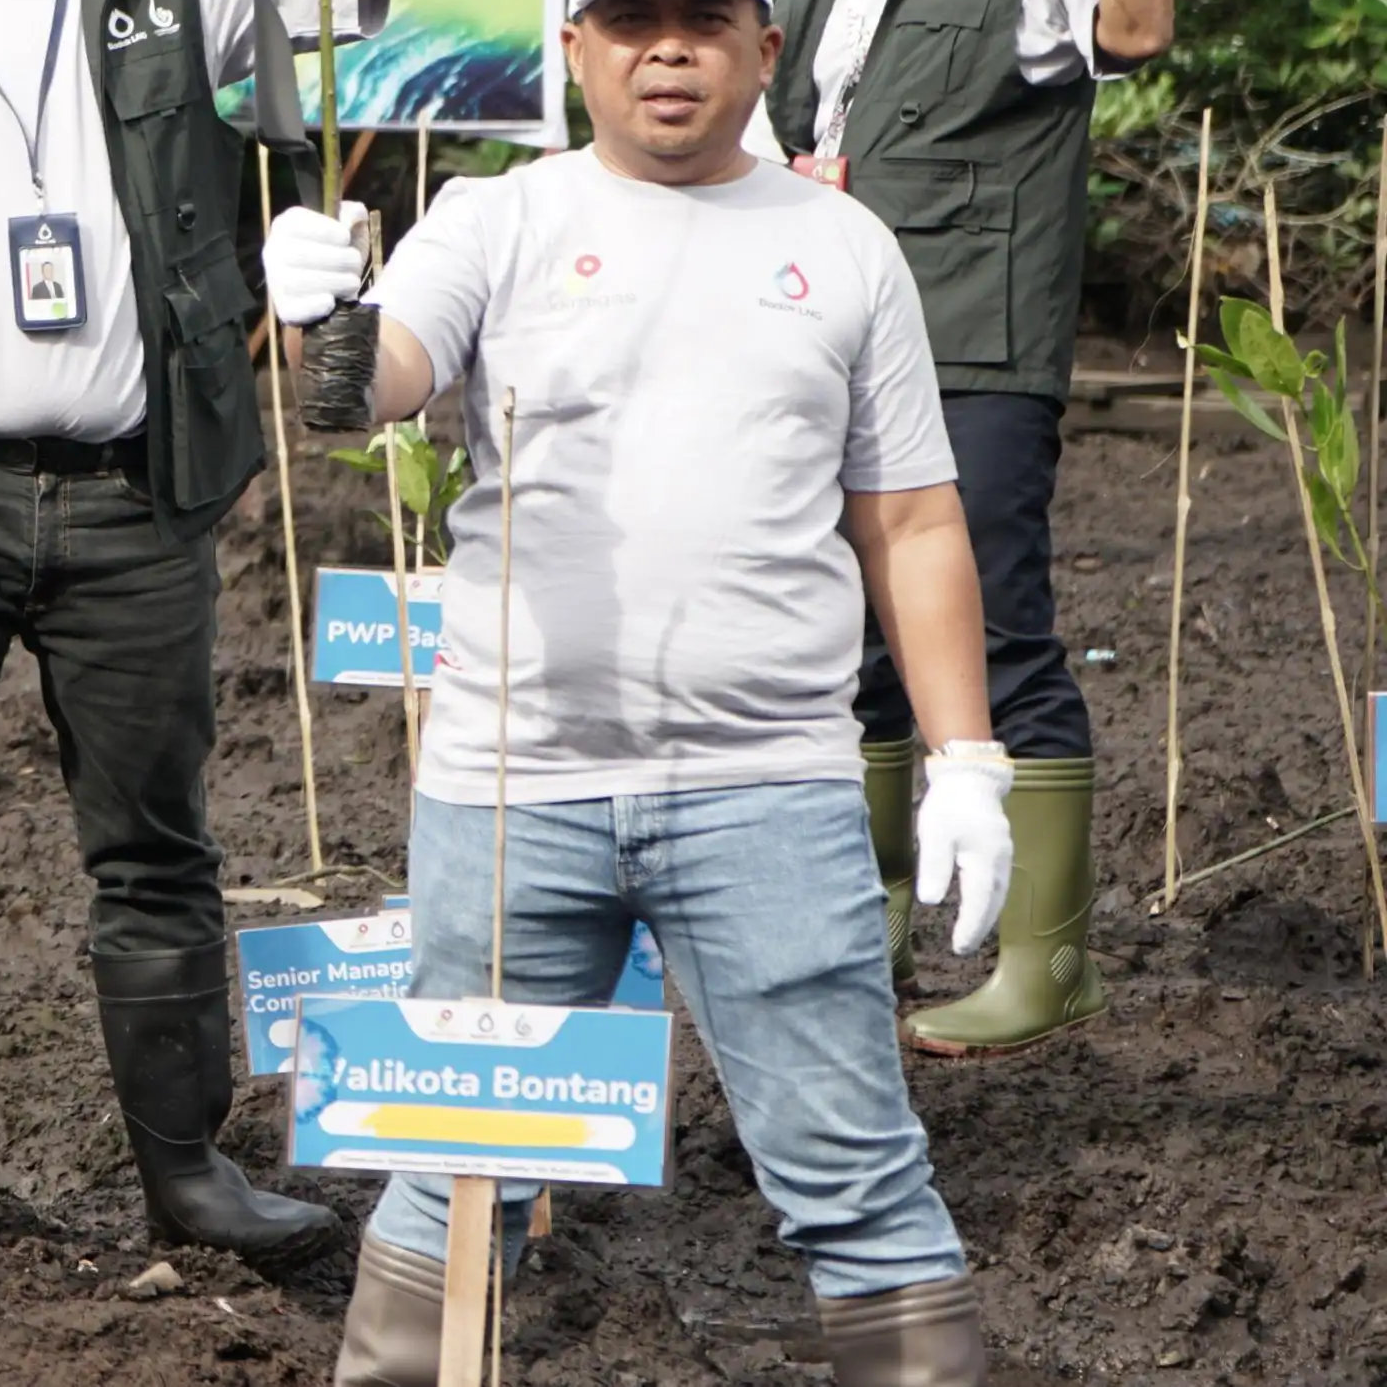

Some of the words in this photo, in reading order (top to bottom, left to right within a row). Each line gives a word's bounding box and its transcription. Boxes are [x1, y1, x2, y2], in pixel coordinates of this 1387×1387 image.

[328, 621, 395, 645] PWP
[248, 967, 321, 990] Senior
[328, 961, 414, 982] Manage
[332, 1058, 480, 1098] alikota
[493, 1066, 659, 1113] Bontang
